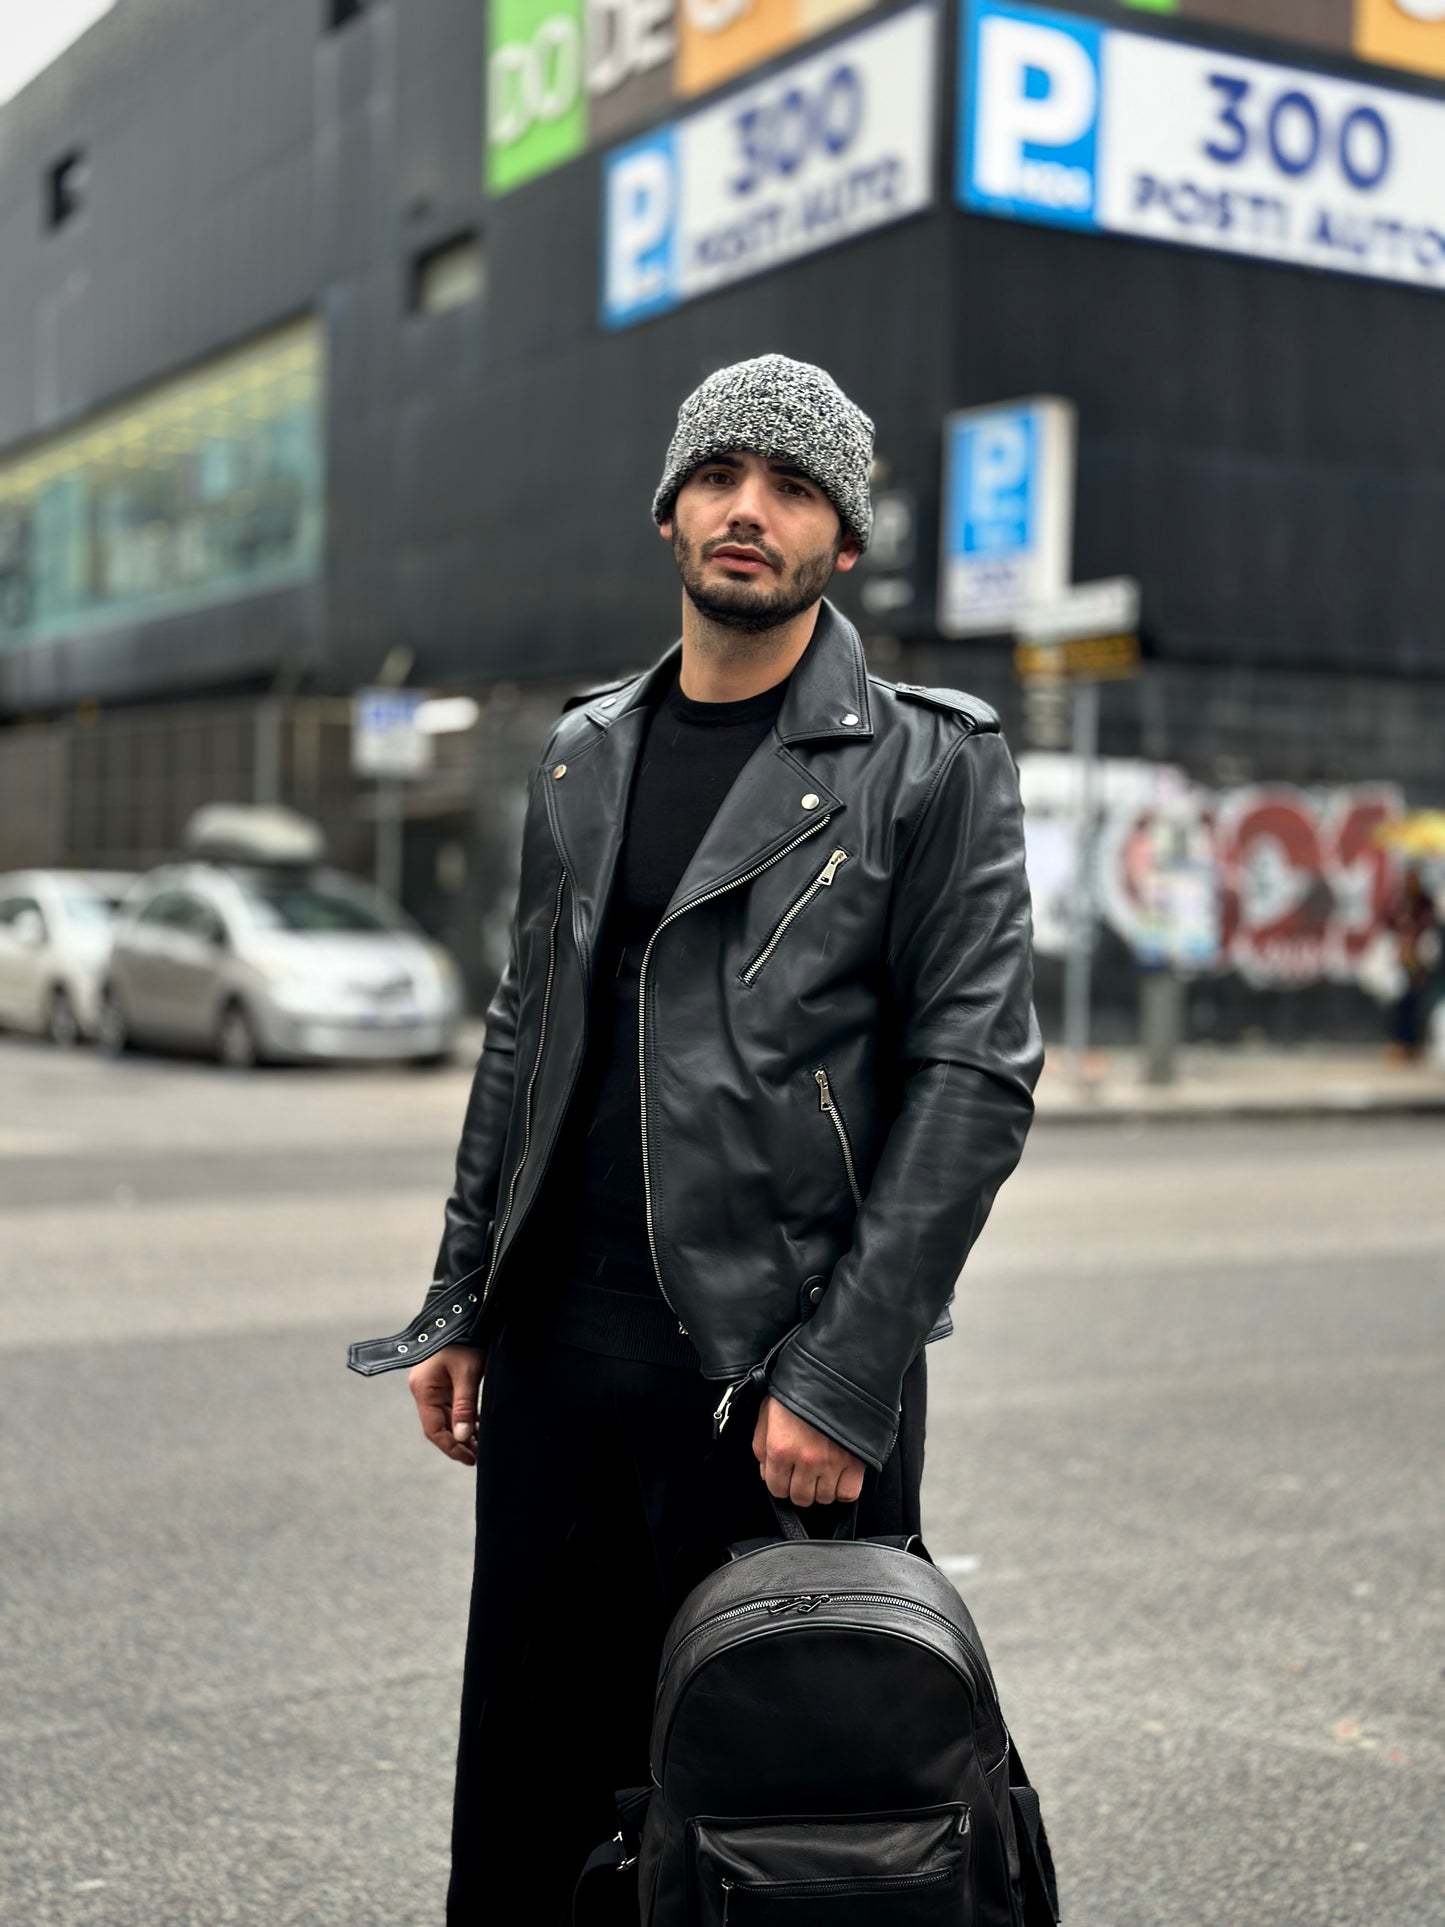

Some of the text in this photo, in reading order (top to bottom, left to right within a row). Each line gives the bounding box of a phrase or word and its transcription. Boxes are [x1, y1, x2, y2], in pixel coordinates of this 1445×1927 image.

[731, 61, 864, 197] 300
[974, 14, 1097, 199] P
[1203, 71, 1391, 191] 300
[608, 150, 672, 312] P
[1134, 172, 1290, 240] POSTI
[1313, 207, 1445, 268] AUTO
